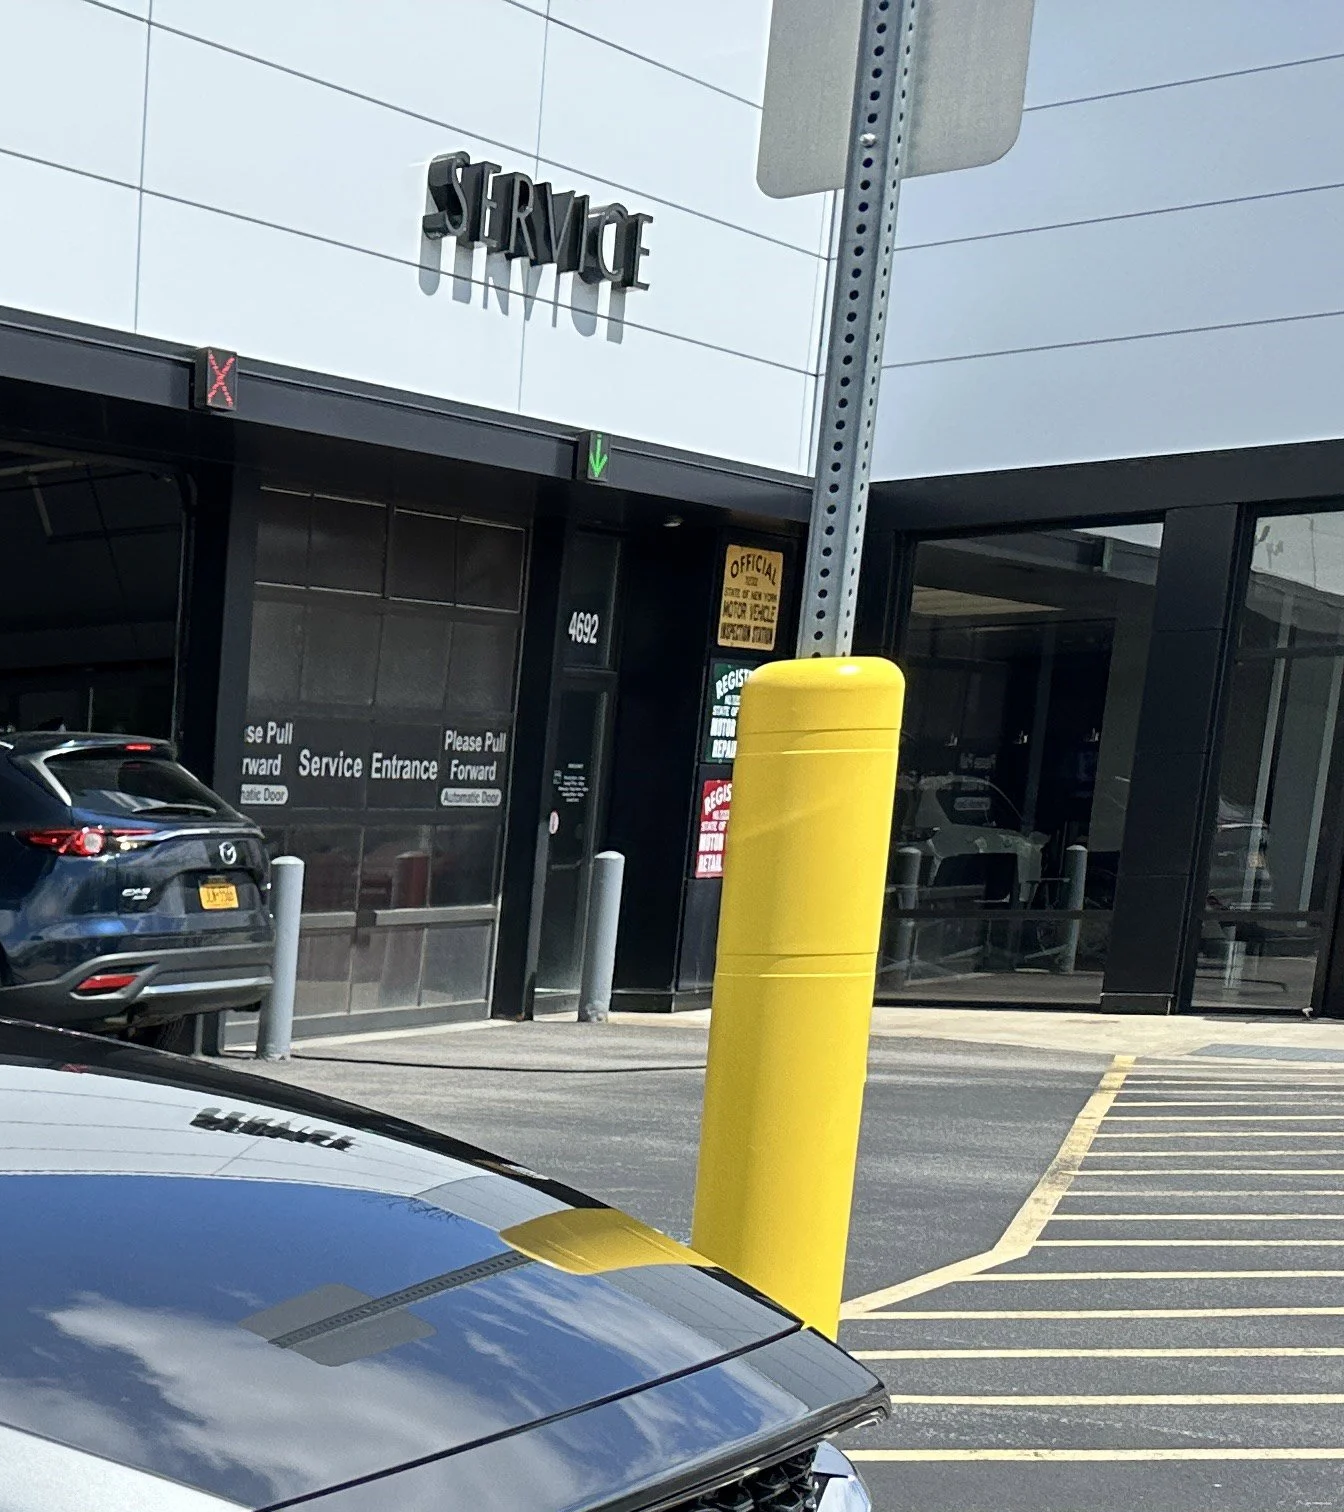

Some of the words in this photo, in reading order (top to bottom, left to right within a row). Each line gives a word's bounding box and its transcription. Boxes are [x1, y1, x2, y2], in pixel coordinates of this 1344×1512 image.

[422, 150, 654, 292] SERVICE
[730, 553, 778, 587] OFFICIAL
[568, 611, 599, 644] 4692
[715, 668, 753, 700] REGIST
[266, 721, 294, 745] Pull
[444, 729, 483, 752] Please
[483, 731, 508, 753] Pull
[241, 753, 282, 776] rward
[298, 748, 364, 778] Service
[370, 752, 439, 780] Entrance
[449, 759, 498, 781] Forward
[263, 787, 286, 802] Door
[443, 790, 481, 804] Automatic
[481, 790, 500, 804] Door
